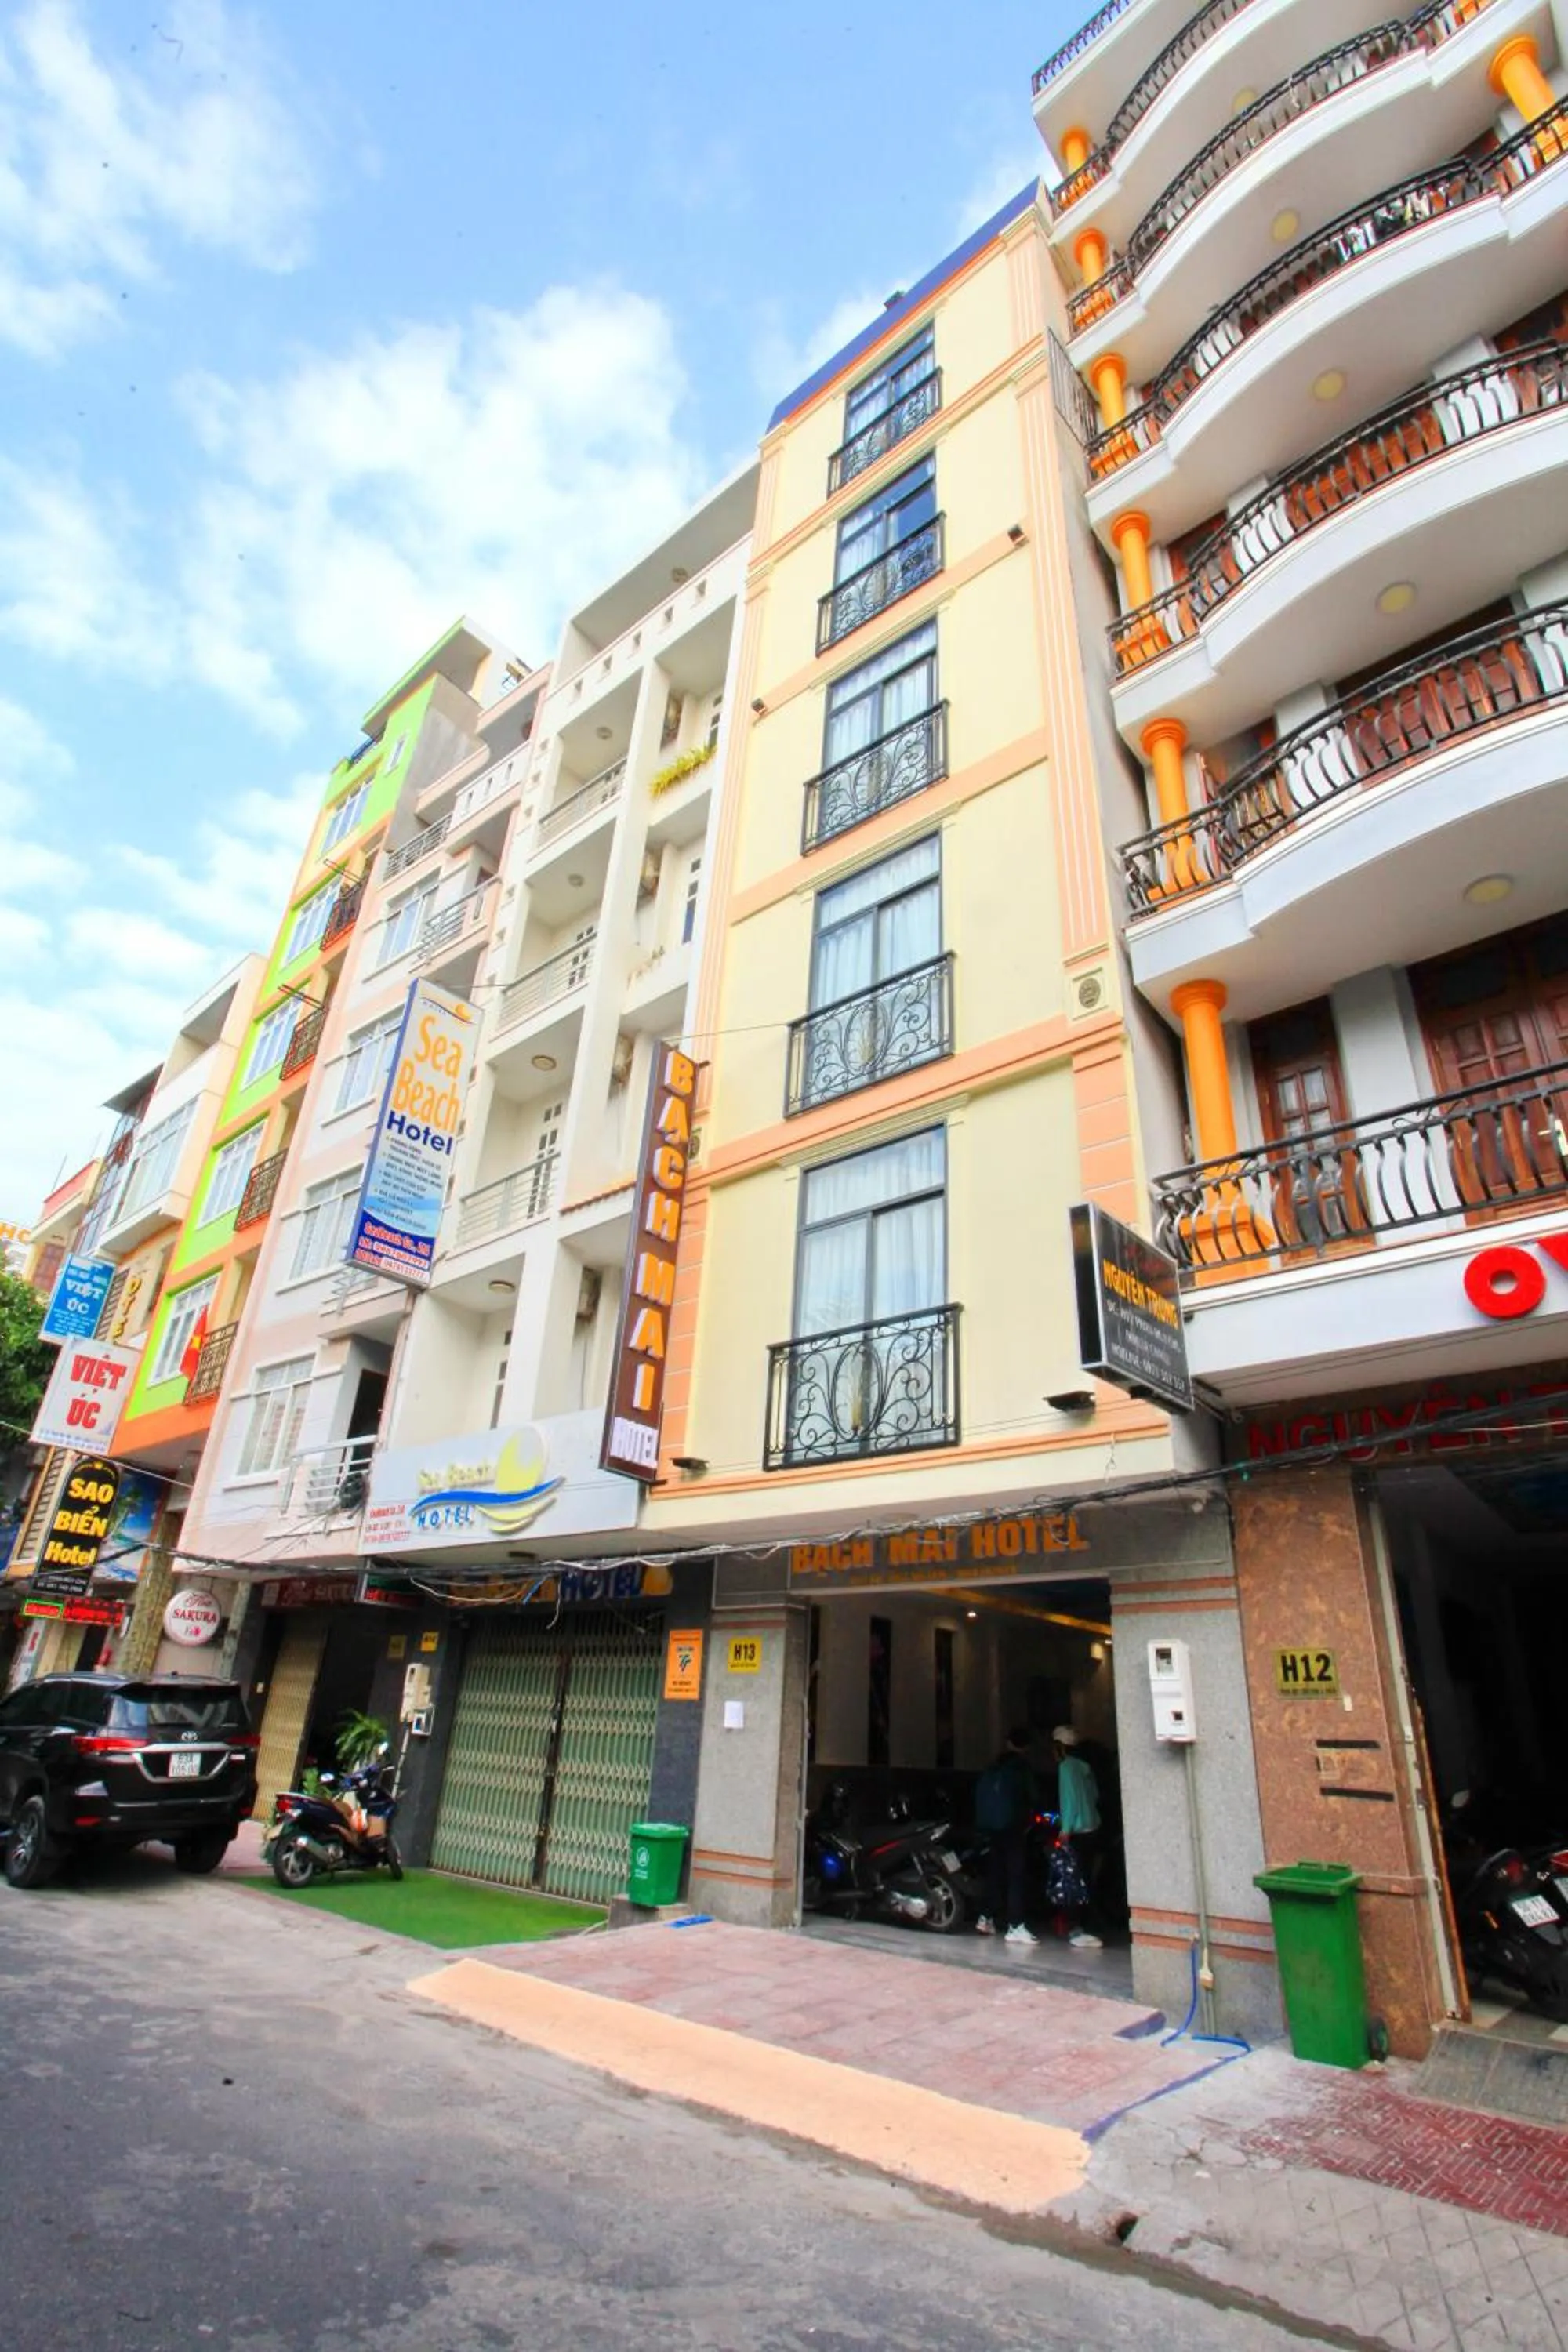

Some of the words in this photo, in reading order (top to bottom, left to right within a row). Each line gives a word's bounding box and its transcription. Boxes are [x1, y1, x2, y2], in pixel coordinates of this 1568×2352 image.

[413, 1014, 463, 1079] Sea
[393, 1057, 460, 1134] Beach
[387, 1109, 453, 1156] Hotel
[628, 1251, 675, 1411] MAI
[70, 1354, 128, 1394] VIỆT
[609, 1417, 659, 1468] HOTEL
[67, 1477, 114, 1504] SAO
[53, 1505, 109, 1537] BIỂN
[417, 1504, 472, 1528] HOTEL
[43, 1540, 98, 1566] Hotel
[889, 1528, 959, 1566] MAI
[971, 1512, 1090, 1559] HOTEL
[172, 1608, 217, 1624] SAKURA
[734, 1643, 756, 1661] H13
[1280, 1653, 1333, 1682] H12
